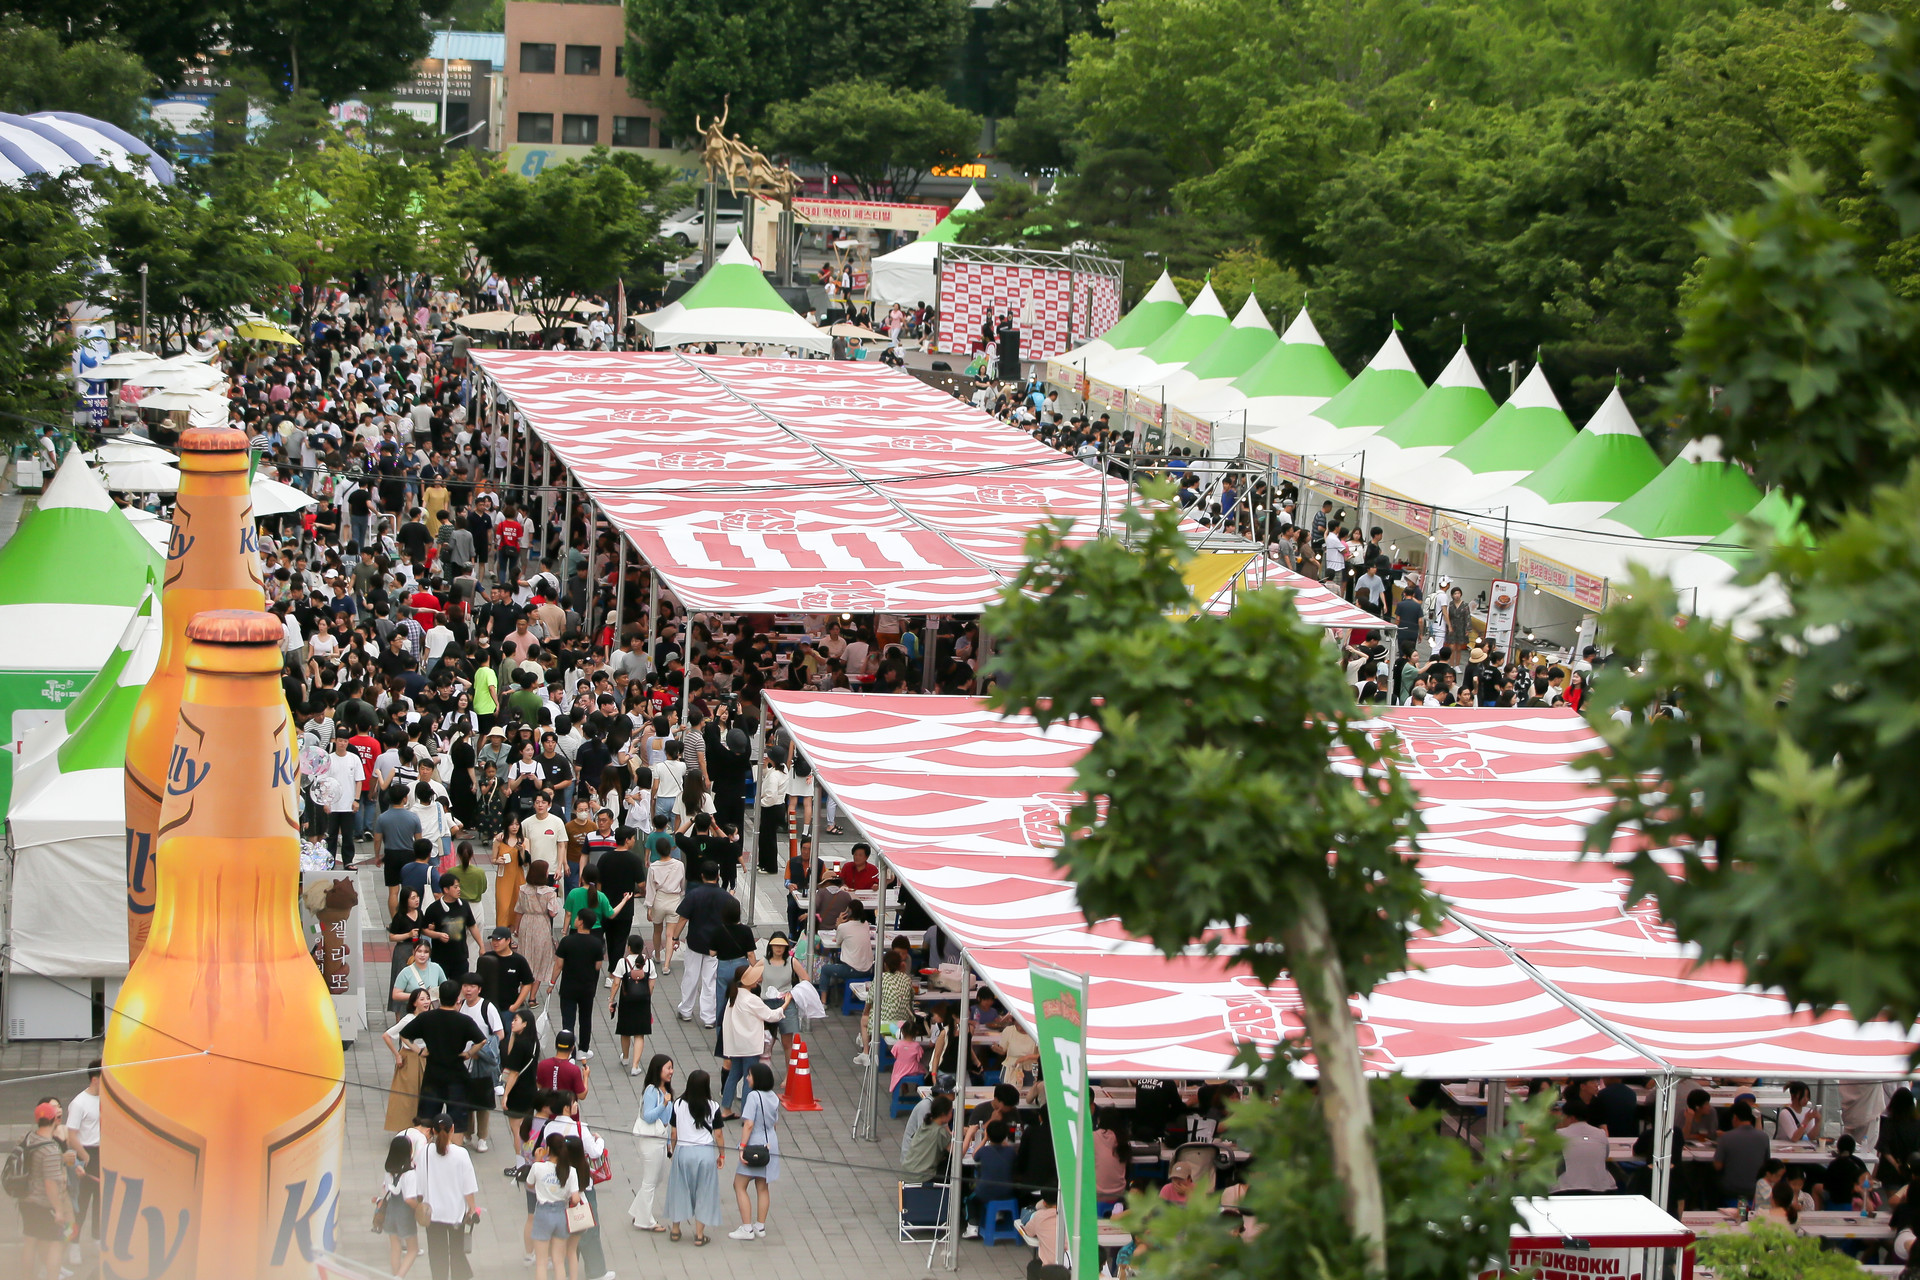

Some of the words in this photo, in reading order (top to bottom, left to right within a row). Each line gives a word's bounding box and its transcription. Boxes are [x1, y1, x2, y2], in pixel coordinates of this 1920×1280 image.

[823, 208, 850, 219] 떡볶이
[854, 210, 891, 222] 페스티벌
[330, 920, 349, 989] 젤라또
[1508, 1250, 1620, 1275] TTEOKBOKKI
